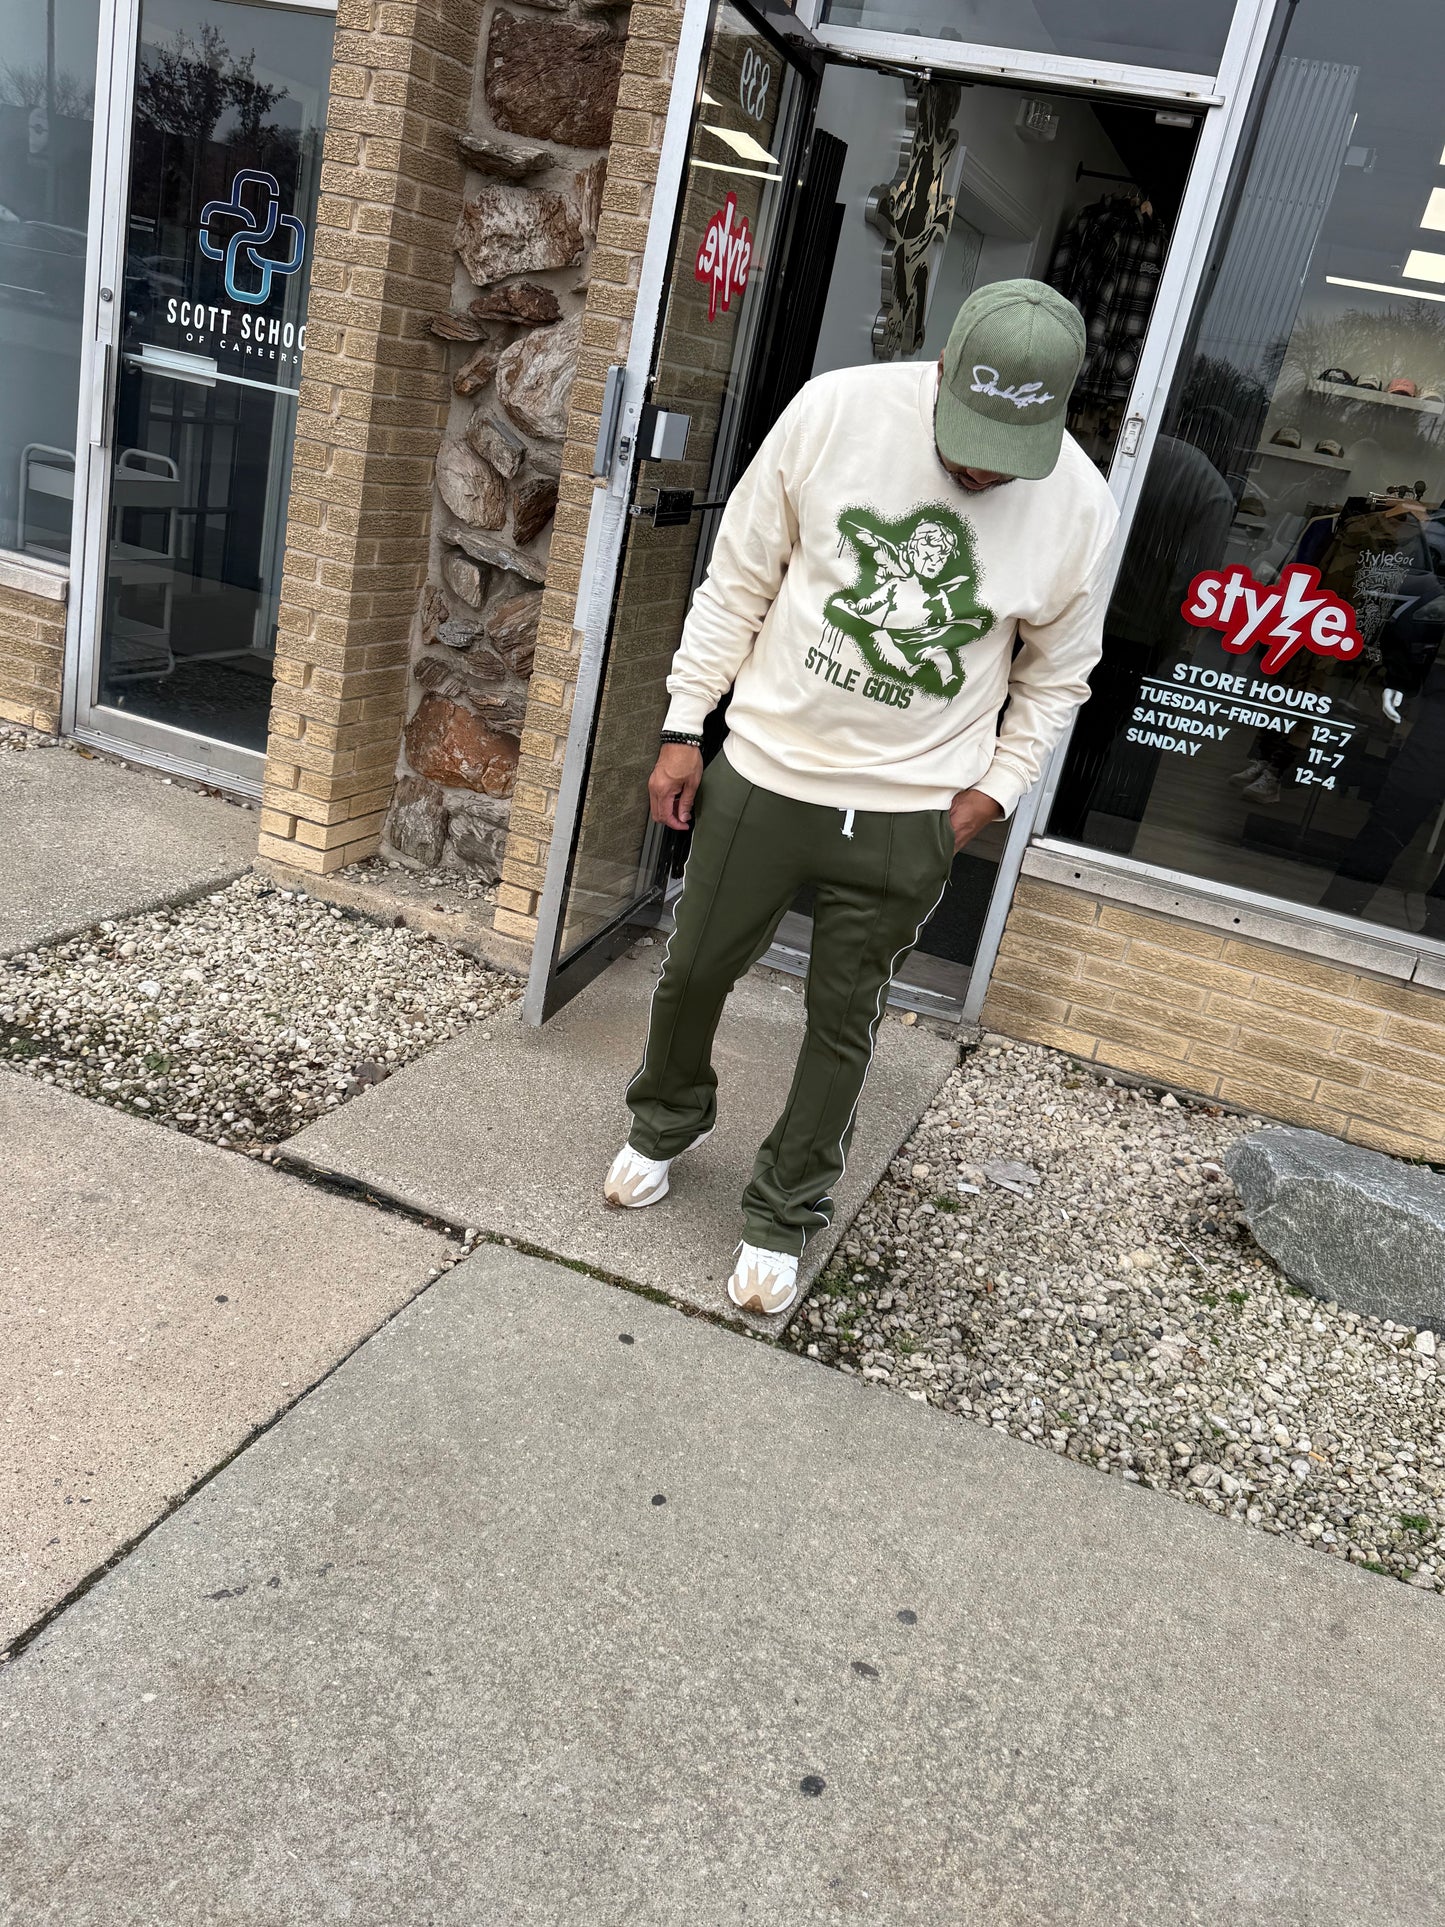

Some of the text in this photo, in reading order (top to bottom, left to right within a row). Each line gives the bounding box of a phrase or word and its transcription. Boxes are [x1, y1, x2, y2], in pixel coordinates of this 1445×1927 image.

[166, 298, 307, 351] SCOTT SCHOO
[186, 333, 299, 364] OF CAREERS
[804, 646, 914, 709] STYLE GODS
[1172, 663, 1333, 714] STORE HOURS
[1131, 706, 1345, 769] SATURDAY 11-7
[1139, 685, 1352, 748] TUESDAY-FRIDAY 12-7
[1126, 727, 1336, 791] SUNDAY 12-4
